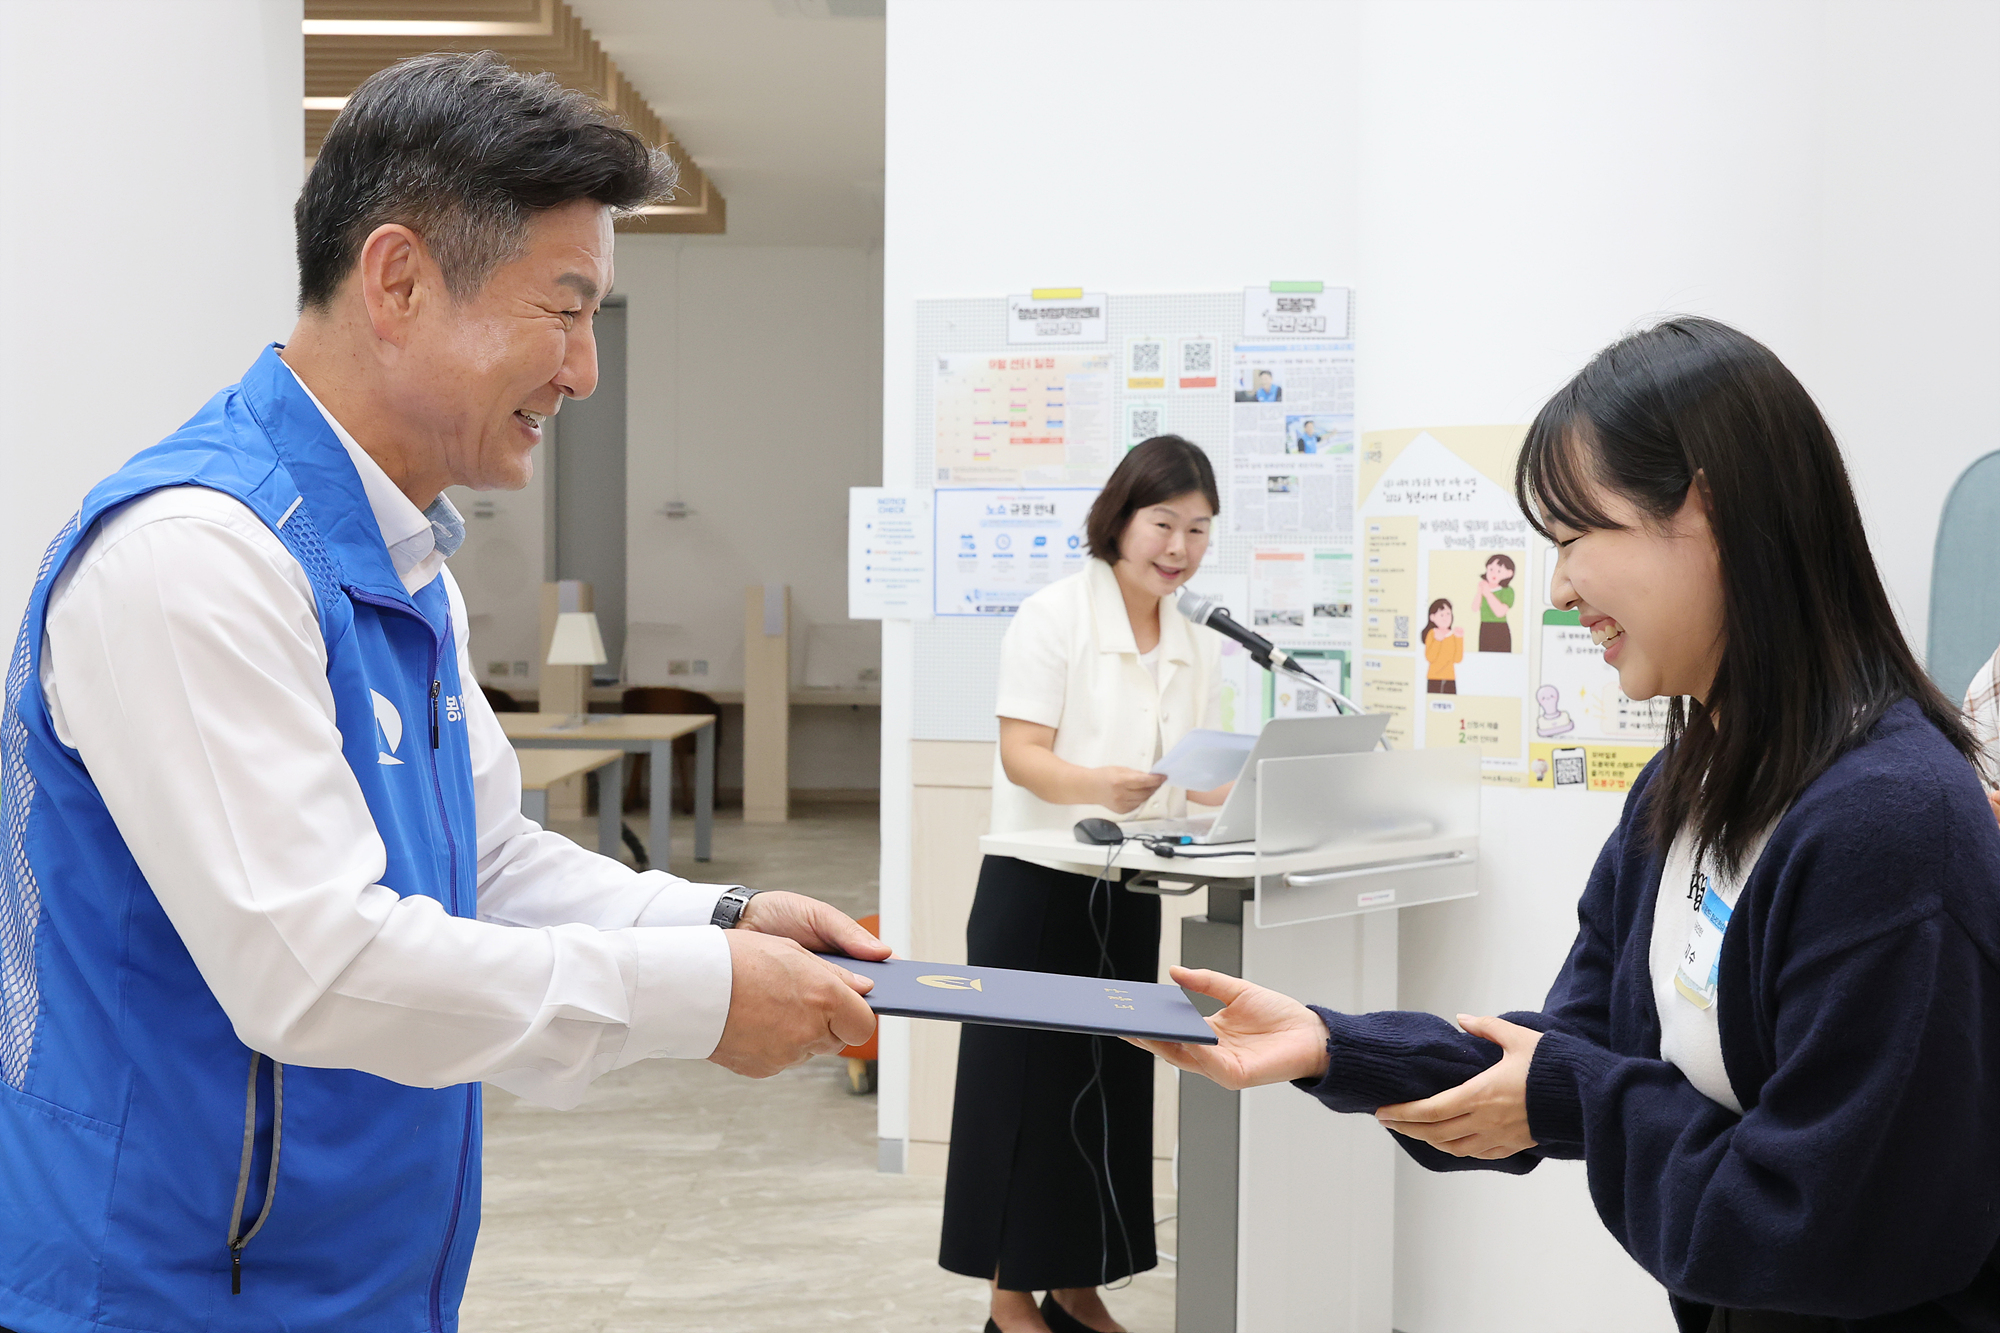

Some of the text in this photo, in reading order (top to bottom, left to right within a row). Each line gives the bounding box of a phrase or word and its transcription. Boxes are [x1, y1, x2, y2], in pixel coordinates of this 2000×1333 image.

[1277, 298, 1316, 312] 도봉구
[986, 504, 1007, 515] 노쇼
[1034, 504, 1055, 515] 안내
[1460, 718, 1465, 730] 1
[1459, 732, 1466, 743] 2
